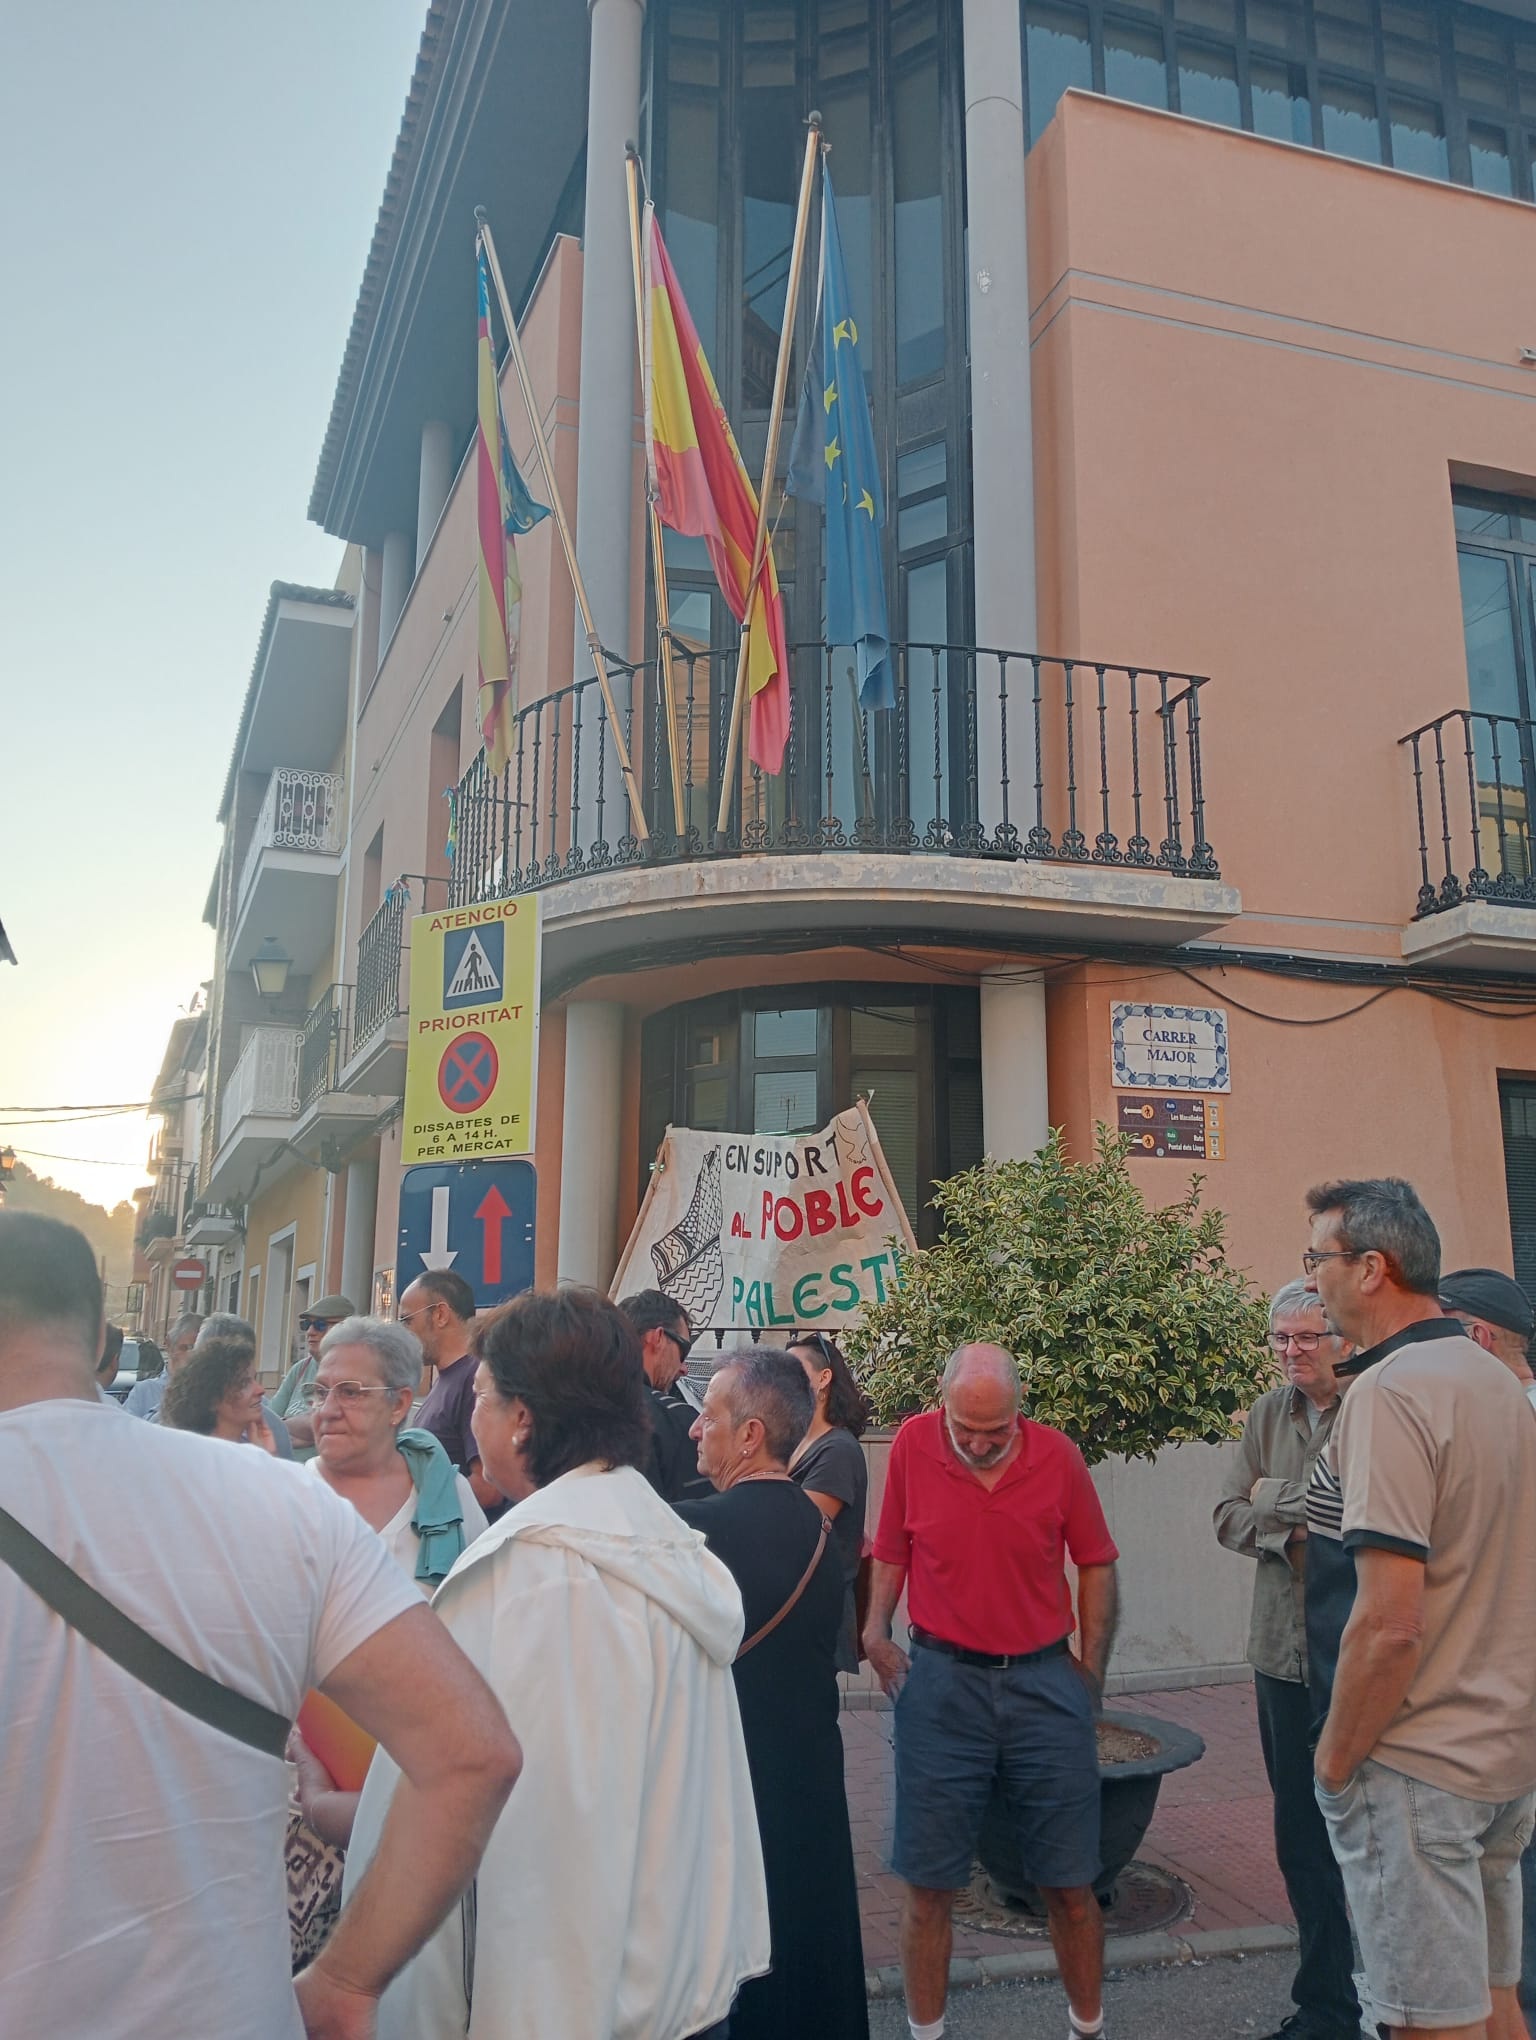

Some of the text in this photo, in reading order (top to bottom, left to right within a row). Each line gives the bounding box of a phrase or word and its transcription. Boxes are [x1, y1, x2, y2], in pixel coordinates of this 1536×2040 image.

[430, 900, 517, 931] ATENCIÓ
[419, 1005, 523, 1034] PRIORITAT
[1143, 1030, 1197, 1044] CARRER
[1148, 1049, 1197, 1063] MAJOR
[413, 1114, 520, 1134] DISSABTES DE
[432, 1129, 497, 1143] 6 A 14 H.
[417, 1139, 513, 1156] PER MERCAT
[726, 1131, 840, 1180] EN SUPORT
[731, 1166, 884, 1242] AL POBLE
